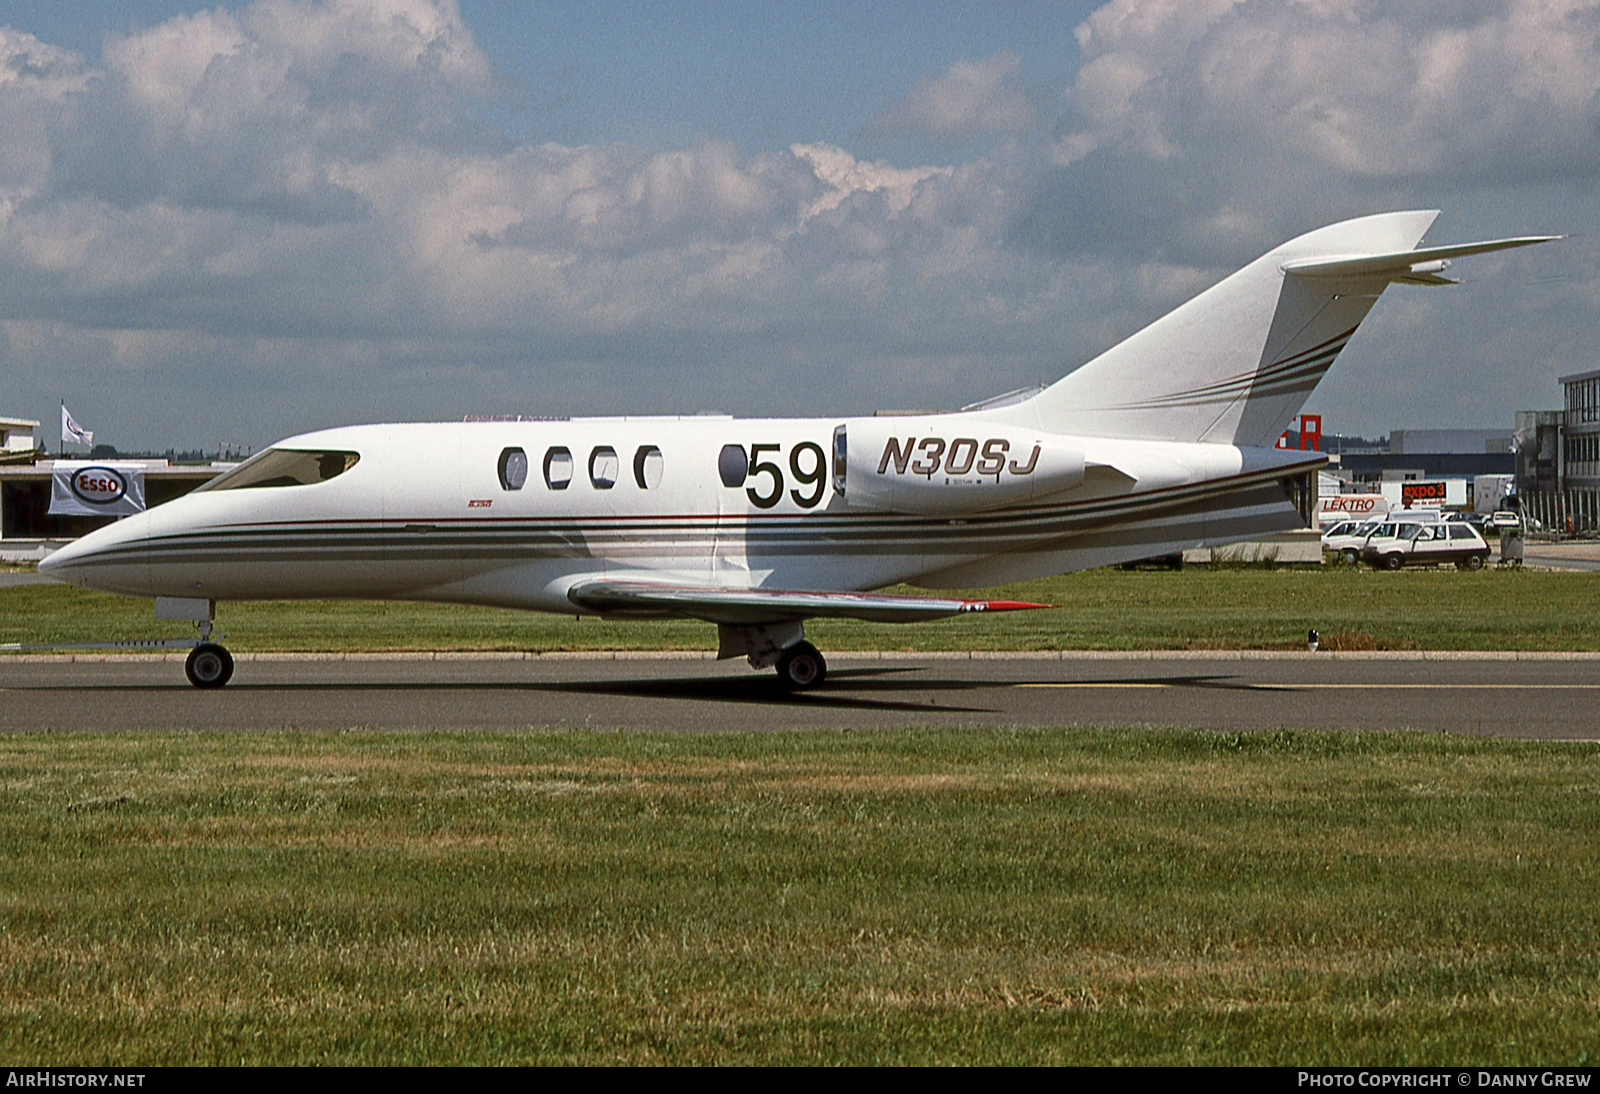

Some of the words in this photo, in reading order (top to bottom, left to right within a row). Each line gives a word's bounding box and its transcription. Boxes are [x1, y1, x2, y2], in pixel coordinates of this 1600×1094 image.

[877, 437, 1042, 475] N30SJ
[746, 442, 828, 510] 59
[1403, 485, 1436, 499] expo
[1437, 483, 1445, 497] 3
[1323, 499, 1375, 511] LEKTRO
